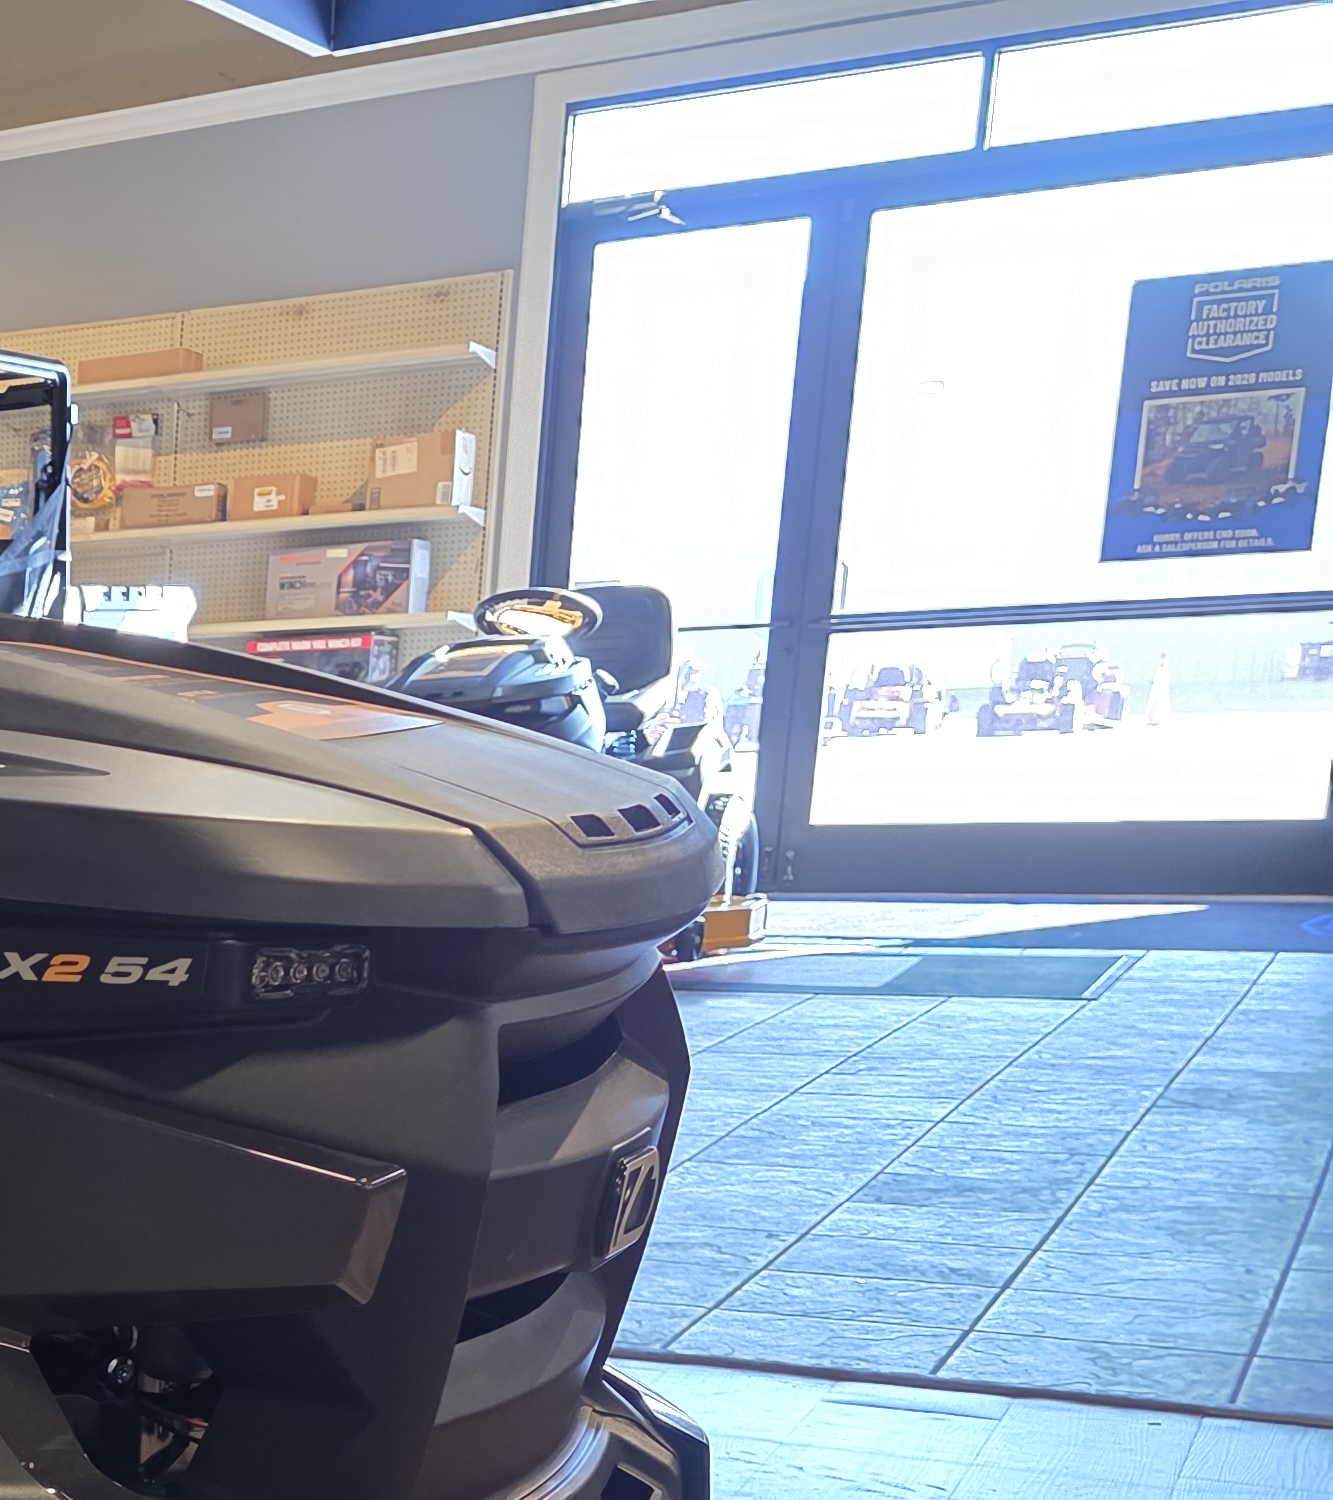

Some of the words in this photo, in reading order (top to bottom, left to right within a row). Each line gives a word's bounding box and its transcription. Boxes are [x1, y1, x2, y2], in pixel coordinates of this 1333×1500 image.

[1202, 299, 1266, 319] FACTORY
[1188, 314, 1277, 336] AUTHORIZED
[1194, 331, 1268, 350] CLEARANCE
[1150, 378, 1180, 392] SAVE
[1181, 377, 1207, 390] NOW
[1210, 375, 1226, 387] ON
[1258, 368, 1303, 383] MODELS
[99, 956, 194, 987] 54
